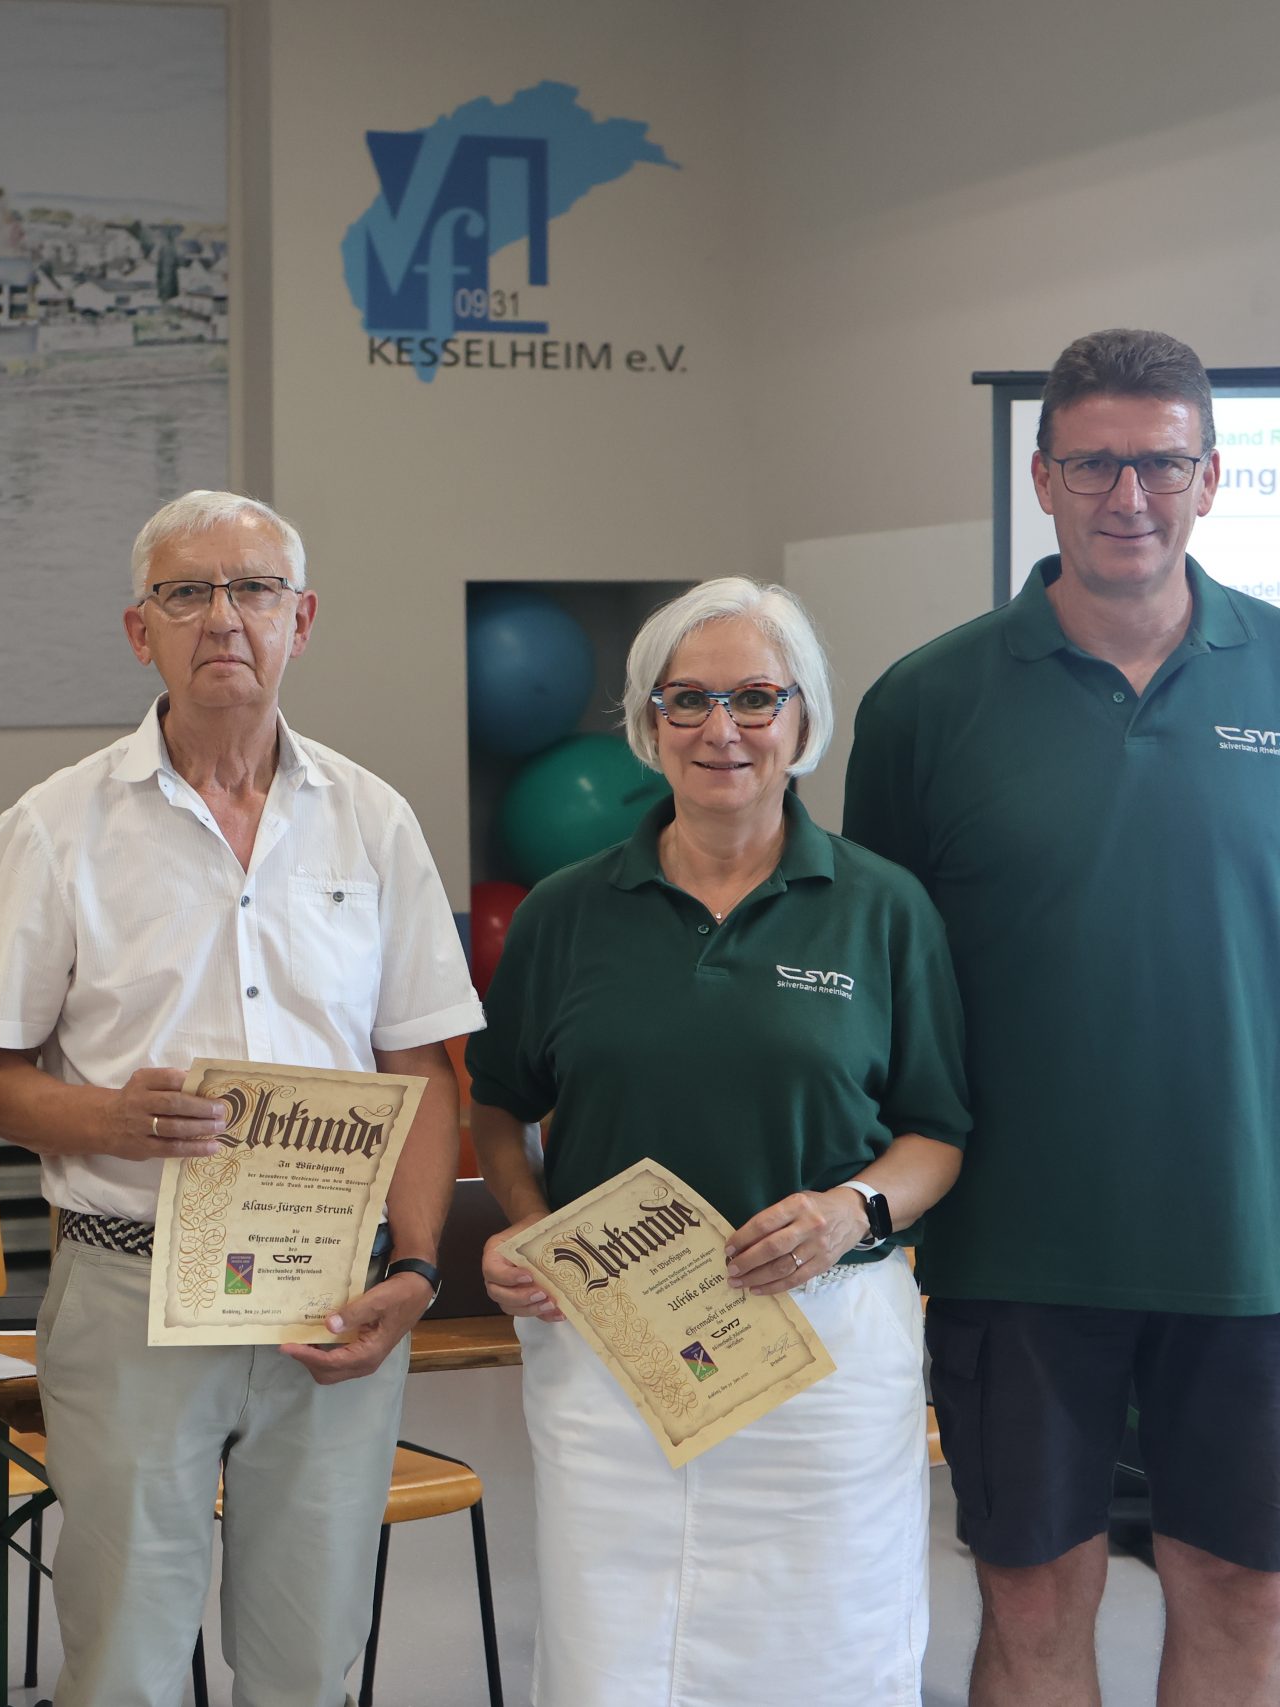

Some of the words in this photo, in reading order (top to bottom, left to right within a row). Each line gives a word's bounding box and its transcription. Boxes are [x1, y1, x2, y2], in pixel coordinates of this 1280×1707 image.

[368, 335, 613, 371] KESSELHEIM
[624, 343, 688, 373] e.V.
[776, 980, 817, 993] Skiverband
[818, 986, 852, 1000] Rheinland
[215, 1085, 393, 1160] Urkunde
[296, 1161, 345, 1174] Würdigung
[241, 1200, 312, 1214] Klaus-Jürgen
[315, 1203, 354, 1215] Strunk
[248, 1234, 296, 1246] Ehrennadel
[301, 1236, 309, 1244] in
[314, 1236, 341, 1245] Silber
[554, 1187, 700, 1295] Urkunde
[667, 1289, 699, 1311] Ulrike
[699, 1274, 724, 1294] Klein
[685, 1311, 720, 1336] Ehrennadel
[719, 1307, 726, 1315] in
